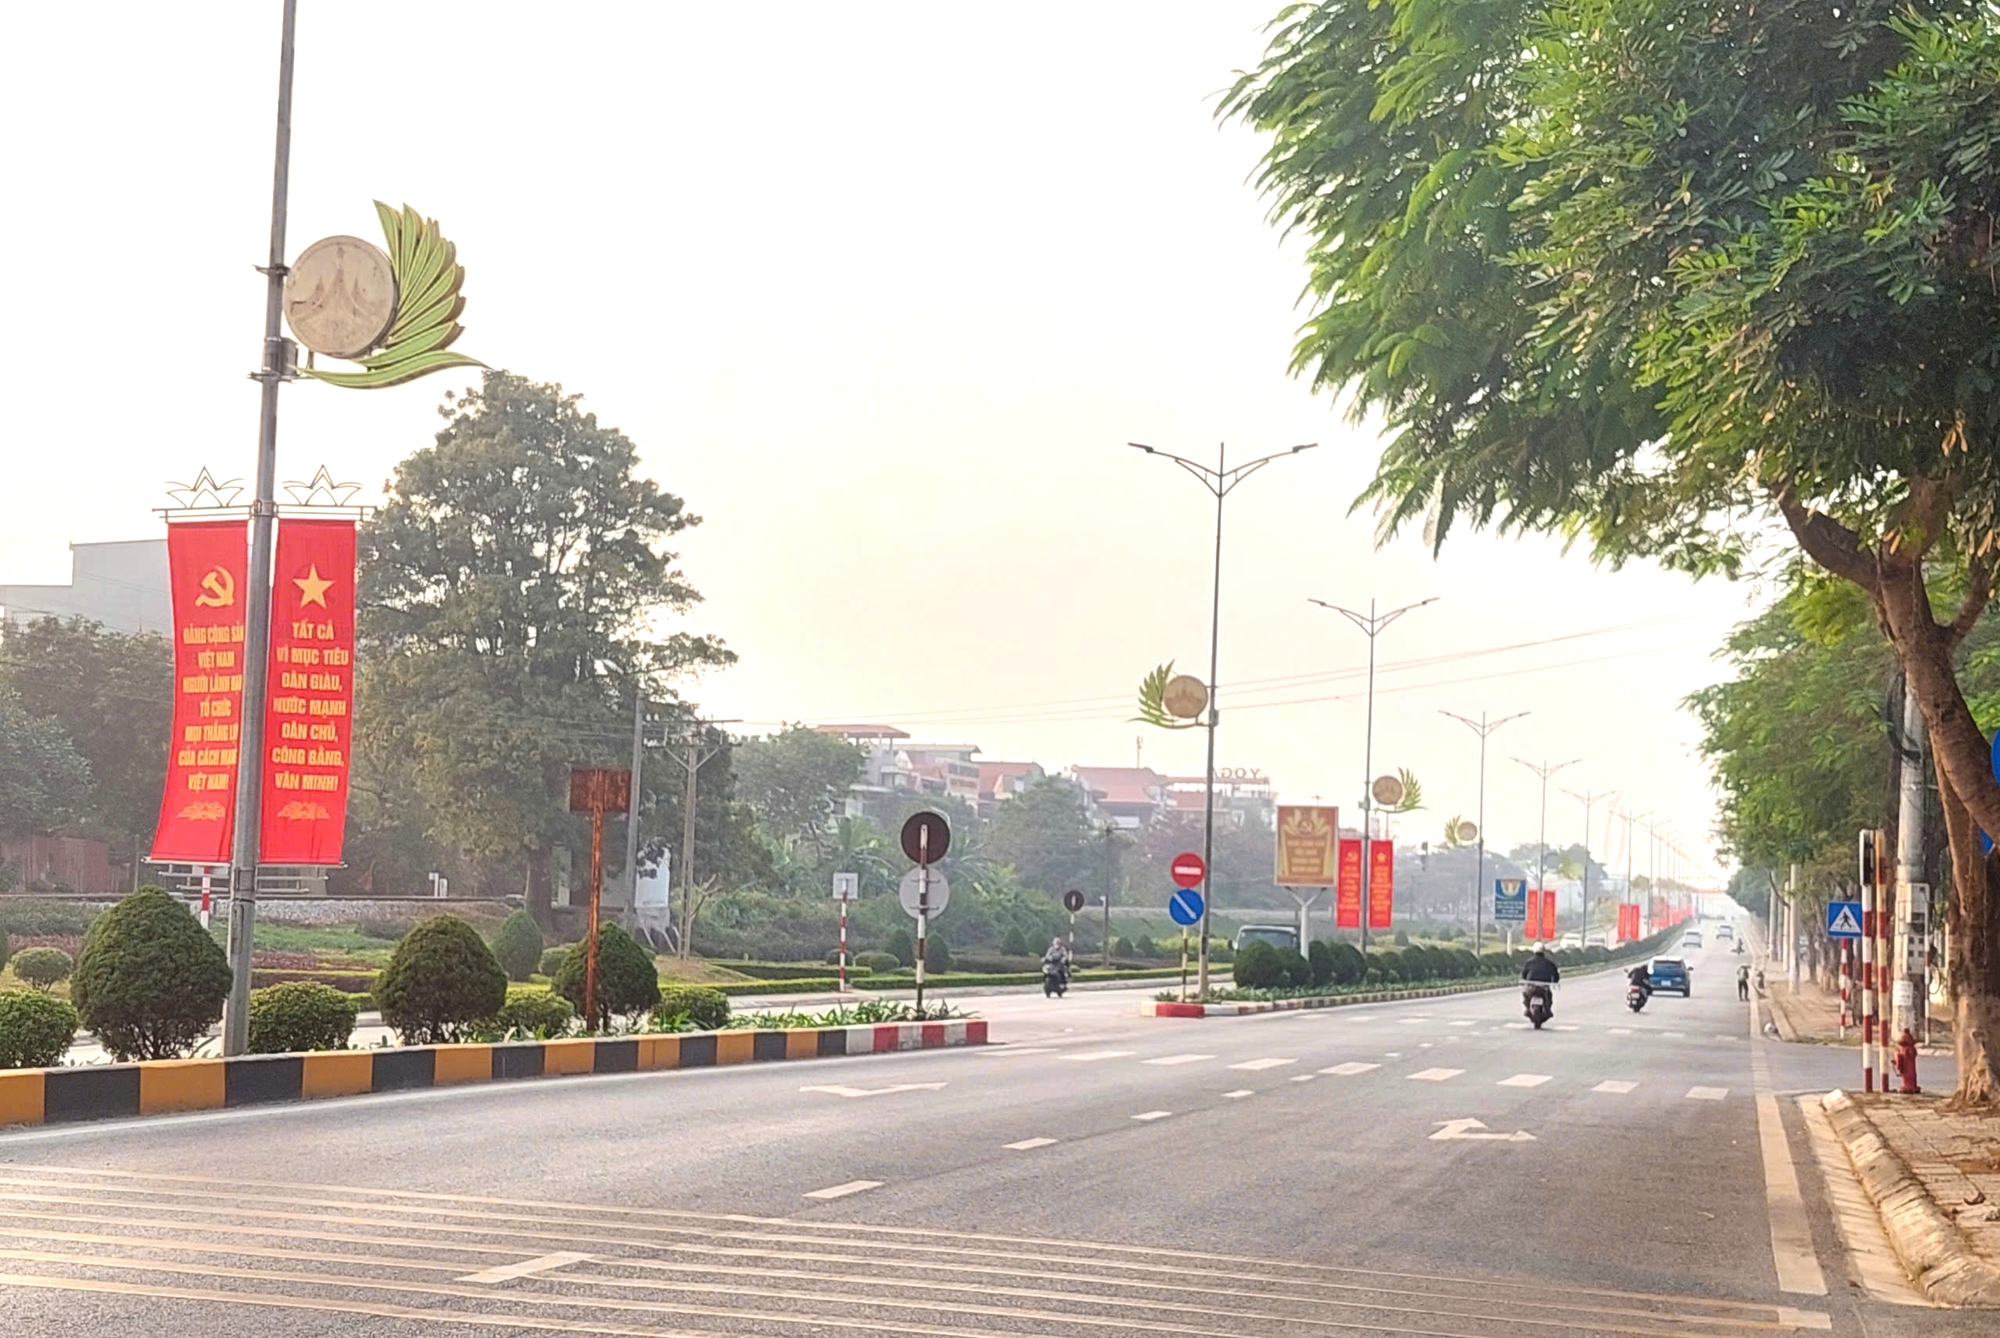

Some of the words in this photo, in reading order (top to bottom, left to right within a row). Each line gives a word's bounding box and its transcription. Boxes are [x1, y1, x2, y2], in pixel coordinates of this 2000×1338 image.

[183, 622, 207, 644] ĐẢNG
[207, 624, 230, 647] CỘNG
[292, 618, 314, 639] TẤT
[317, 619, 335, 640] CẢ
[198, 649, 215, 671] VIỆT
[216, 651, 235, 668] NAM
[276, 644, 289, 663] VÌ
[291, 647, 319, 667] MỤC
[323, 646, 349, 666] TIÊU
[281, 669, 308, 689] DÂN
[310, 671, 343, 693] GIÀU,
[211, 697, 232, 717] CHỨC
[273, 695, 306, 714] NƯỚC
[309, 699, 347, 719] MẠNH
[229, 722, 239, 744] LỢ
[281, 720, 308, 740] DÂN
[178, 744, 196, 766] CỦA
[197, 746, 220, 766] CÁCH
[220, 748, 238, 769] MẠN
[272, 744, 306, 765] CÔNG
[188, 771, 207, 793] VIỆT
[275, 770, 300, 790] VĂN
[302, 774, 339, 791] MINH!
